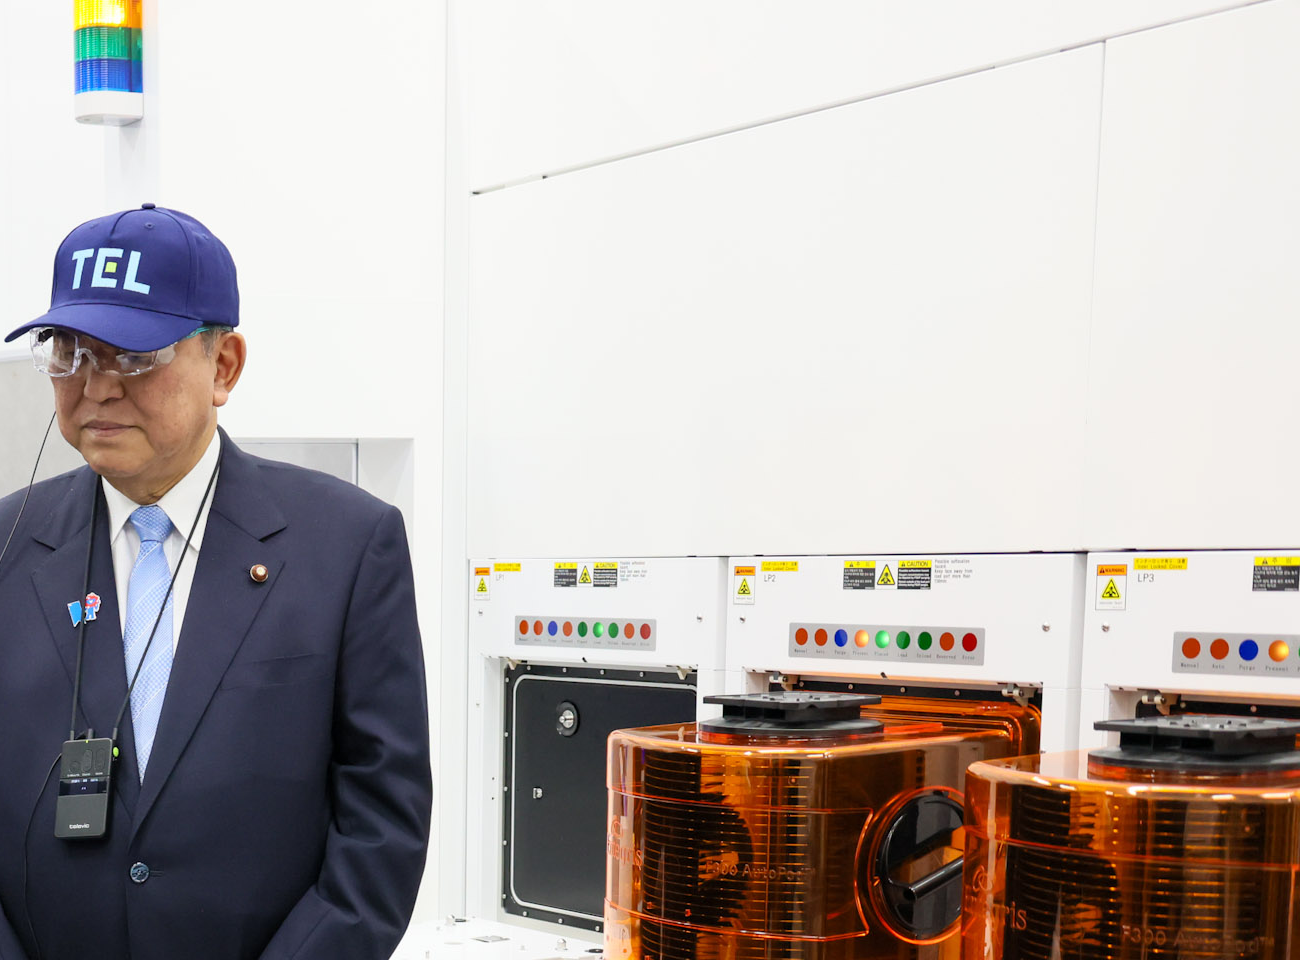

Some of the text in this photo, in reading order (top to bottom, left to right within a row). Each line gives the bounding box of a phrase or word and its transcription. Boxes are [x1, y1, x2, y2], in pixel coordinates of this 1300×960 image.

[72, 248, 150, 295] TEL
[764, 574, 776, 582] LP2
[1137, 573, 1154, 583] LP3
[705, 858, 739, 877] F300
[1121, 924, 1167, 946] F300
